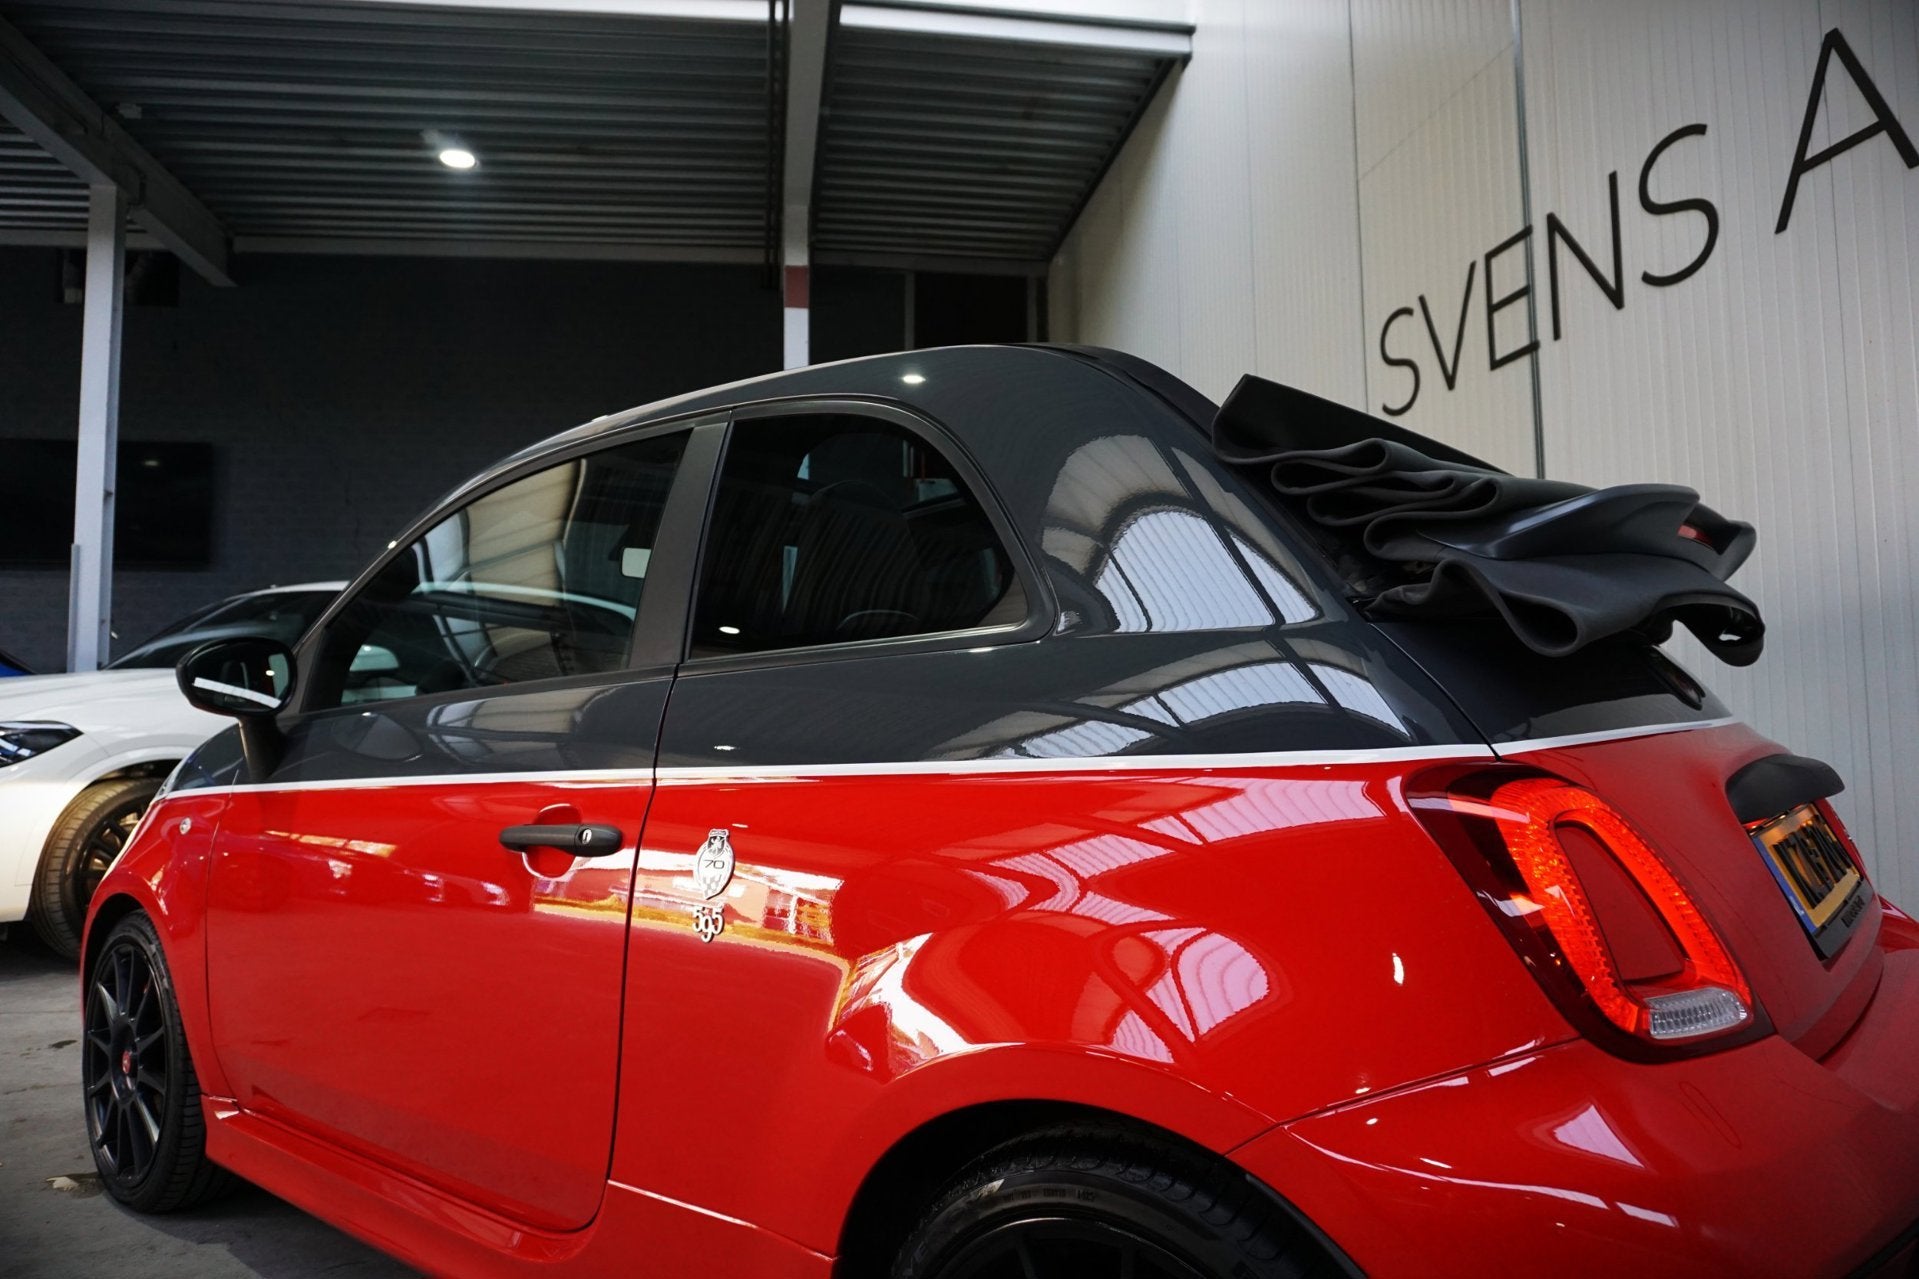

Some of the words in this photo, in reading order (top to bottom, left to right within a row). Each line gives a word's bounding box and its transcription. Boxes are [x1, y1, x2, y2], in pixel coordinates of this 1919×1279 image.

[1380, 123, 1719, 416] SVENS
[1775, 27, 1919, 234] A
[704, 859, 725, 869] 70
[693, 905, 723, 943] 595
